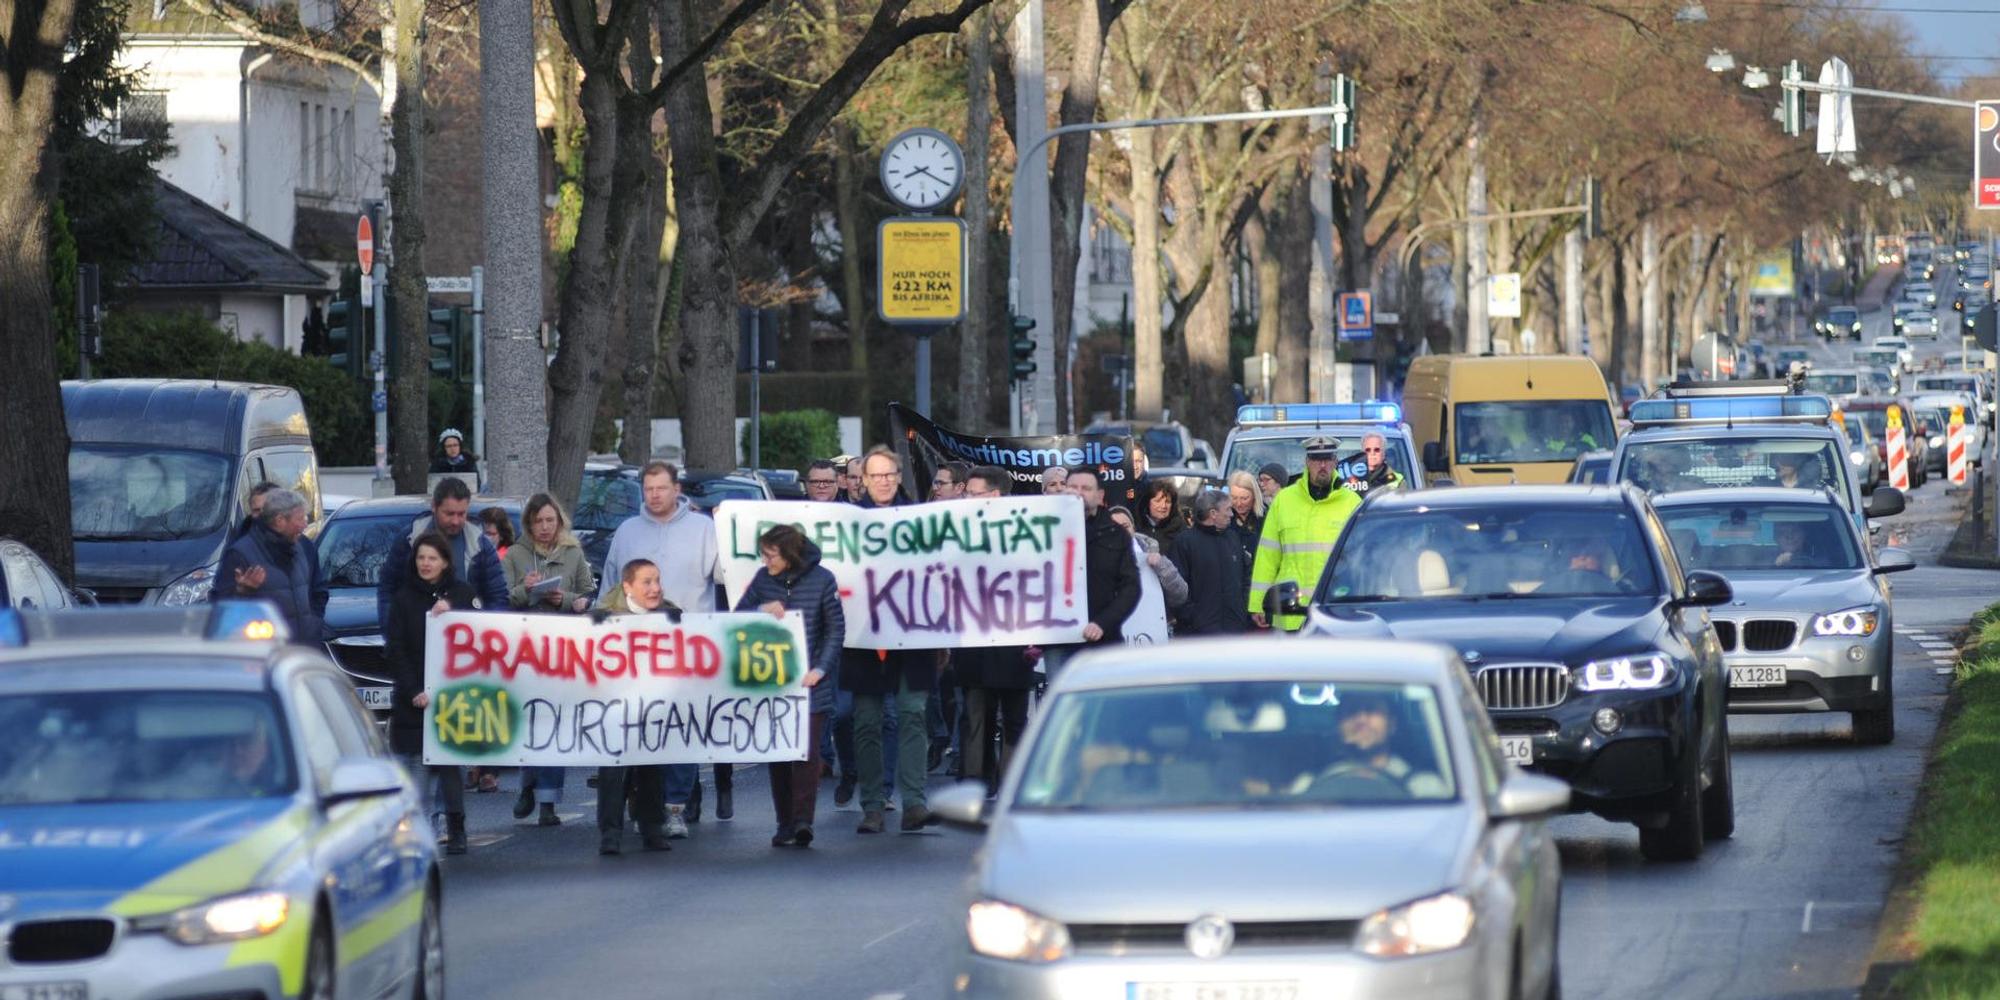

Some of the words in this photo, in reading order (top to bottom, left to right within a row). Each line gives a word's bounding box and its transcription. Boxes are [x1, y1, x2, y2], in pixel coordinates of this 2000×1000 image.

[892, 271, 916, 279] NUR
[919, 271, 951, 279] NOCH
[892, 281, 920, 291] 422
[926, 281, 952, 291] KM
[892, 293, 908, 301] BIS
[911, 293, 951, 301] AFRIKA
[938, 430, 1125, 467] Martinsmeile
[1008, 470, 1044, 483] Nove
[1101, 469, 1126, 482] 018
[731, 508, 1061, 564] LENSQUALiTÄT
[444, 623, 721, 685] BRAUNSFELD
[1734, 668, 1744, 682] X
[1747, 668, 1783, 682] 1281
[365, 690, 380, 704] AC
[522, 695, 807, 756] DURCHGANGSORT
[1505, 741, 1529, 758] 16
[0, 829, 144, 848] LIZEI
